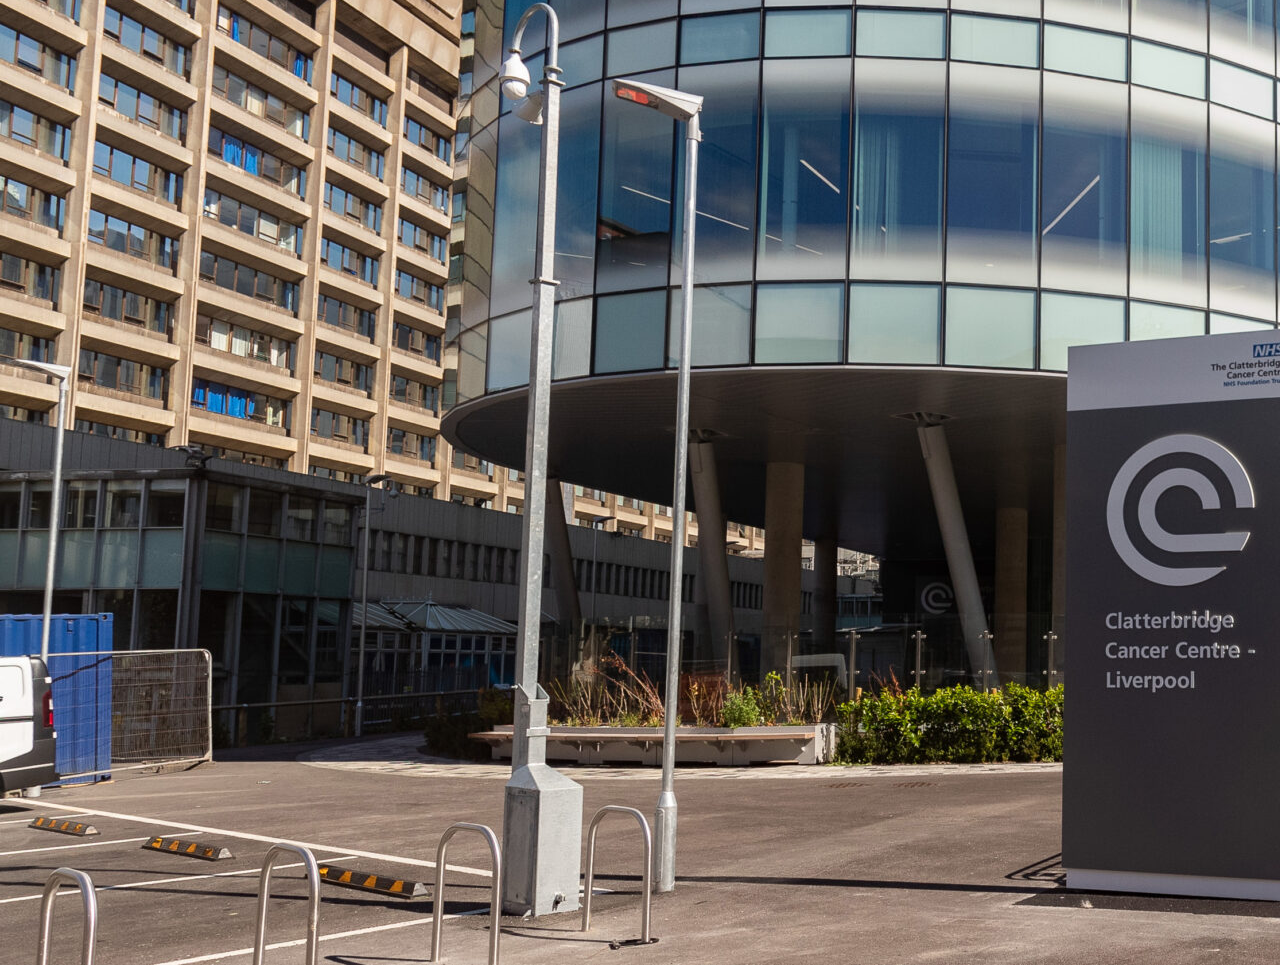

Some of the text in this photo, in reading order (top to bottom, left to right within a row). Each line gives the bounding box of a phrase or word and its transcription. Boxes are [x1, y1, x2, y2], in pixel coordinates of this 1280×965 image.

[1211, 363, 1226, 371] The
[1227, 371, 1255, 379] Cancer
[1105, 610, 1235, 633] Clatterbridge
[1105, 641, 1169, 659] Cancer
[1175, 641, 1240, 659] Centre
[1106, 670, 1195, 693] Liverpool
